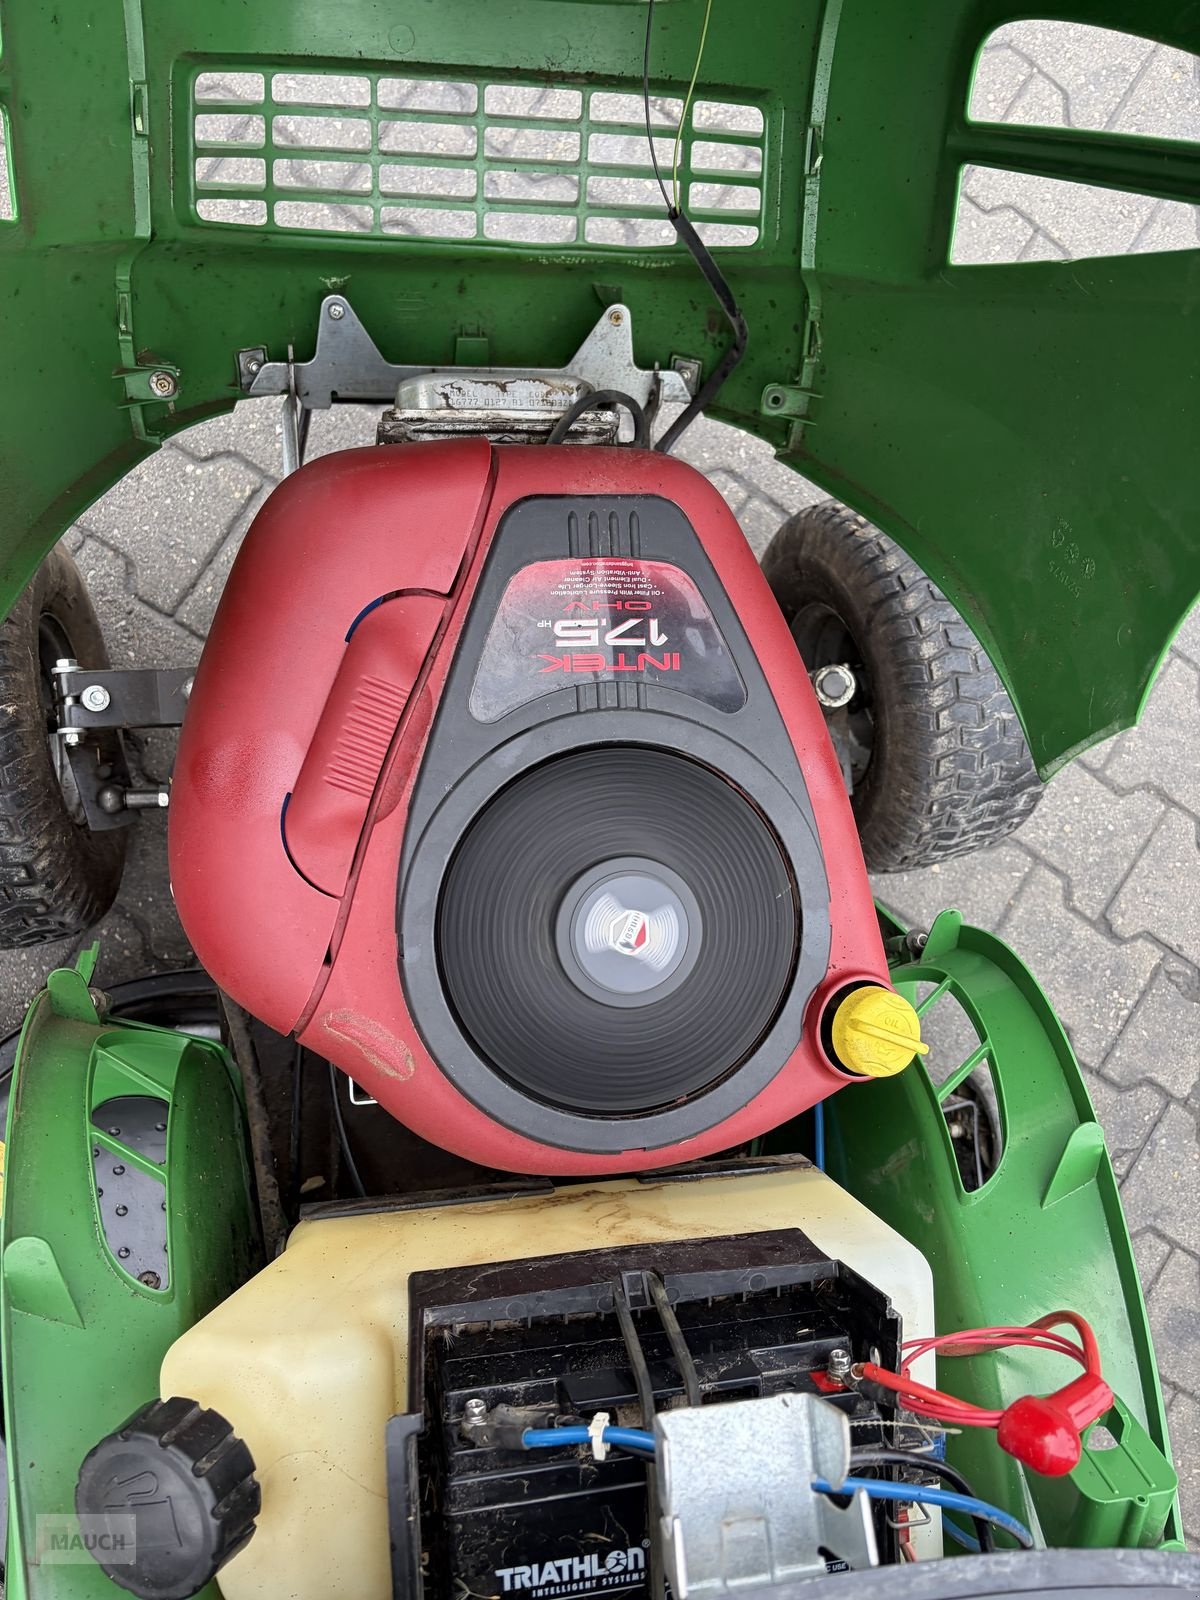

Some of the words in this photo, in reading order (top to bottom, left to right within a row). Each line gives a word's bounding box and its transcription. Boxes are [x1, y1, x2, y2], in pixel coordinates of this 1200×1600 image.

[562, 600, 652, 611] OHV
[536, 620, 552, 628] HP
[553, 617, 668, 647] 17.5
[536, 652, 680, 672] INTEK
[884, 1016, 899, 1028] OIL
[532, 1579, 597, 1598] INTELLIGENT
[601, 1571, 646, 1587] SYSTEMS
